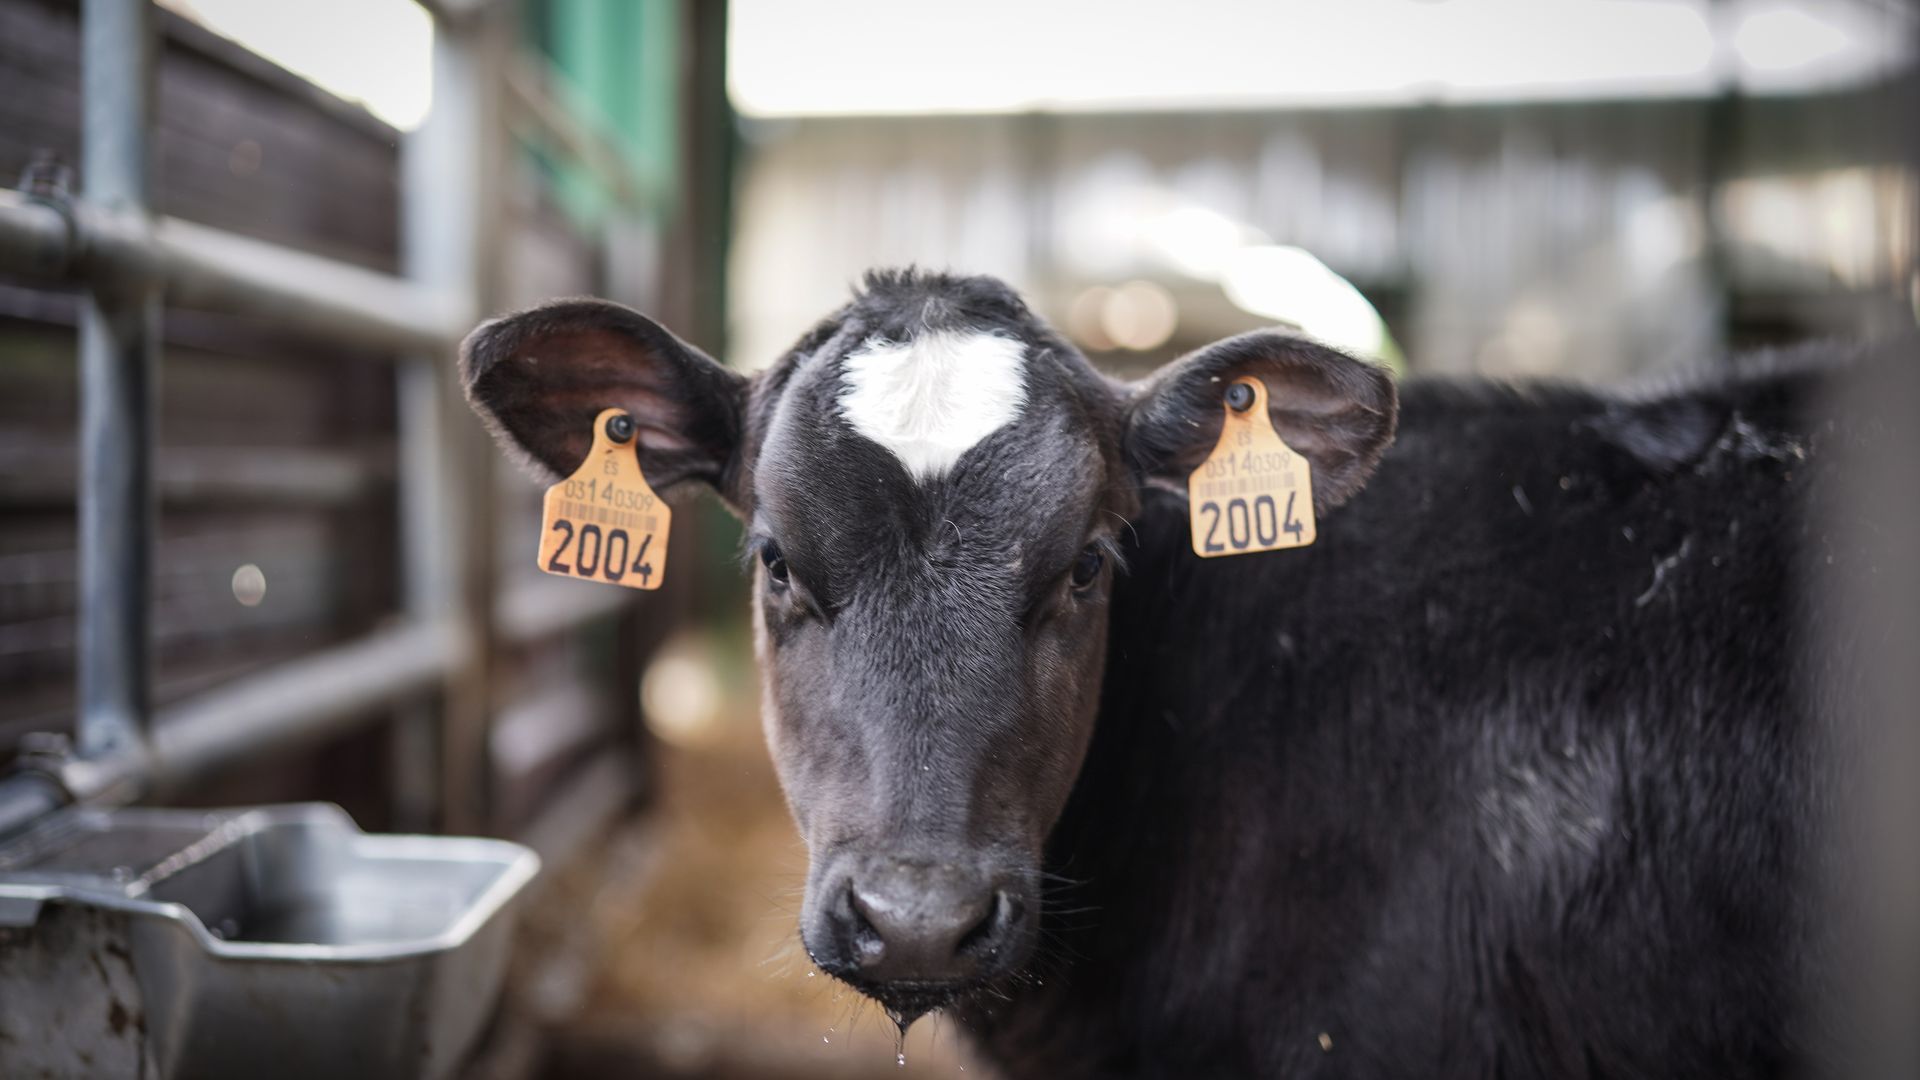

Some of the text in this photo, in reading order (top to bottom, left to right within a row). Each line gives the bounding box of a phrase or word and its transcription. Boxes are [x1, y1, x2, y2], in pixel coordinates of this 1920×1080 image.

[1237, 431, 1252, 446] ES
[603, 459, 619, 476] ES
[564, 477, 654, 512] 03140309
[1200, 491, 1303, 553] 2004
[548, 519, 653, 587] 2004
